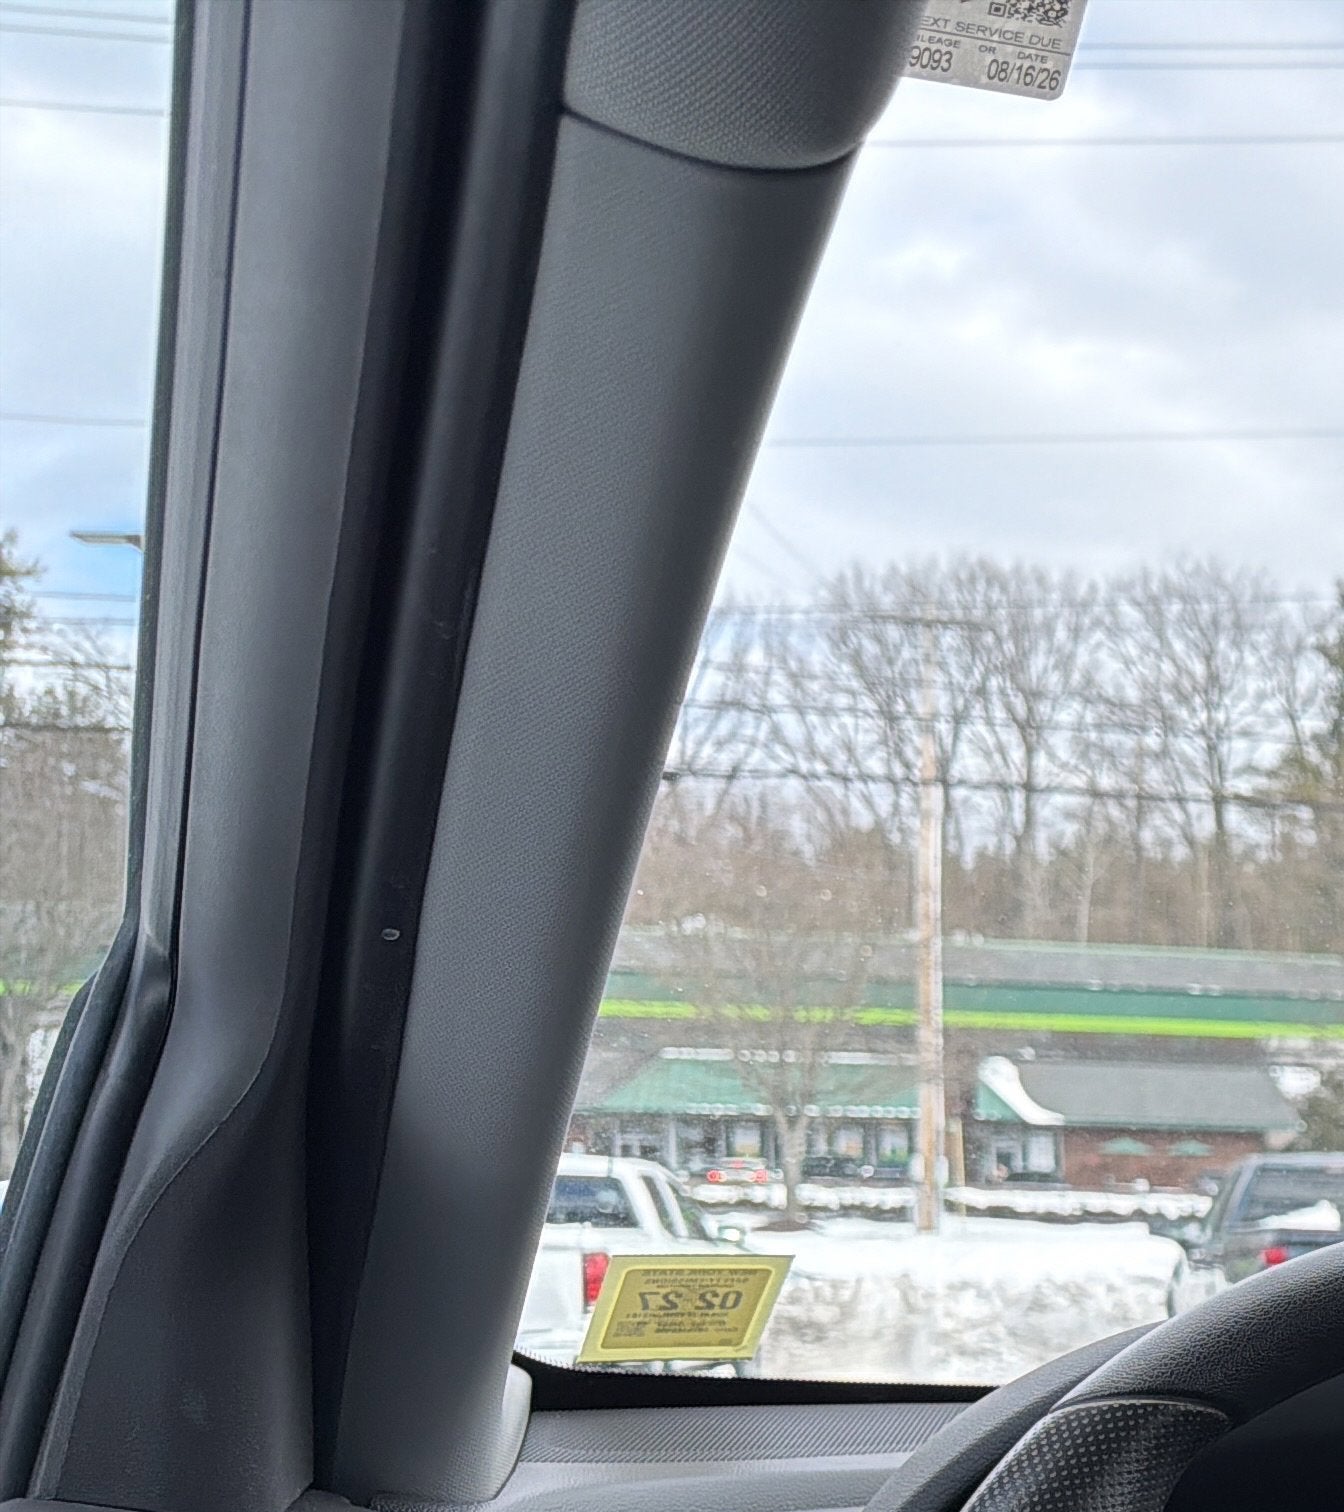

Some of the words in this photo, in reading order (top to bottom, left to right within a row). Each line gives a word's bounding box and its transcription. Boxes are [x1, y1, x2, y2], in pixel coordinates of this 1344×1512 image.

[921, 15, 951, 29] EXT
[955, 21, 1025, 43] SERVICE
[1029, 34, 1064, 49] DUE
[916, 34, 962, 49] ILEAGE
[978, 44, 997, 55] OR
[1017, 51, 1049, 64] DATE
[986, 58, 1062, 91] 08/16/26
